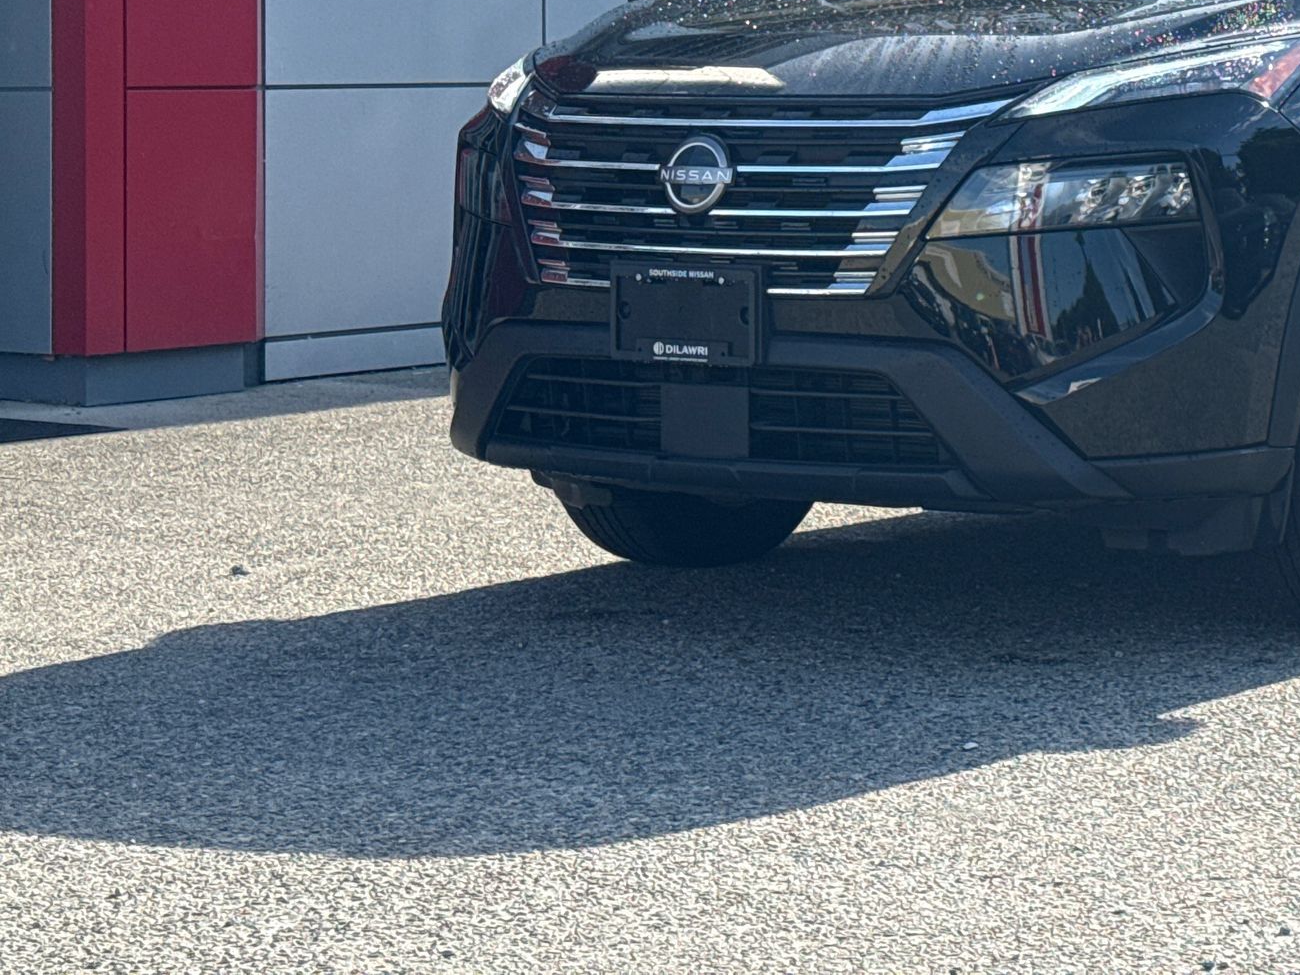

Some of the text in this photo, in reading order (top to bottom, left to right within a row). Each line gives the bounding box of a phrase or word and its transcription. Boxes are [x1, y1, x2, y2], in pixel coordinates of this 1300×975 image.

[659, 167, 732, 183] NISSAN
[649, 269, 714, 279] SOUTHSIDE NISSAN
[665, 344, 709, 356] DILAWRI
